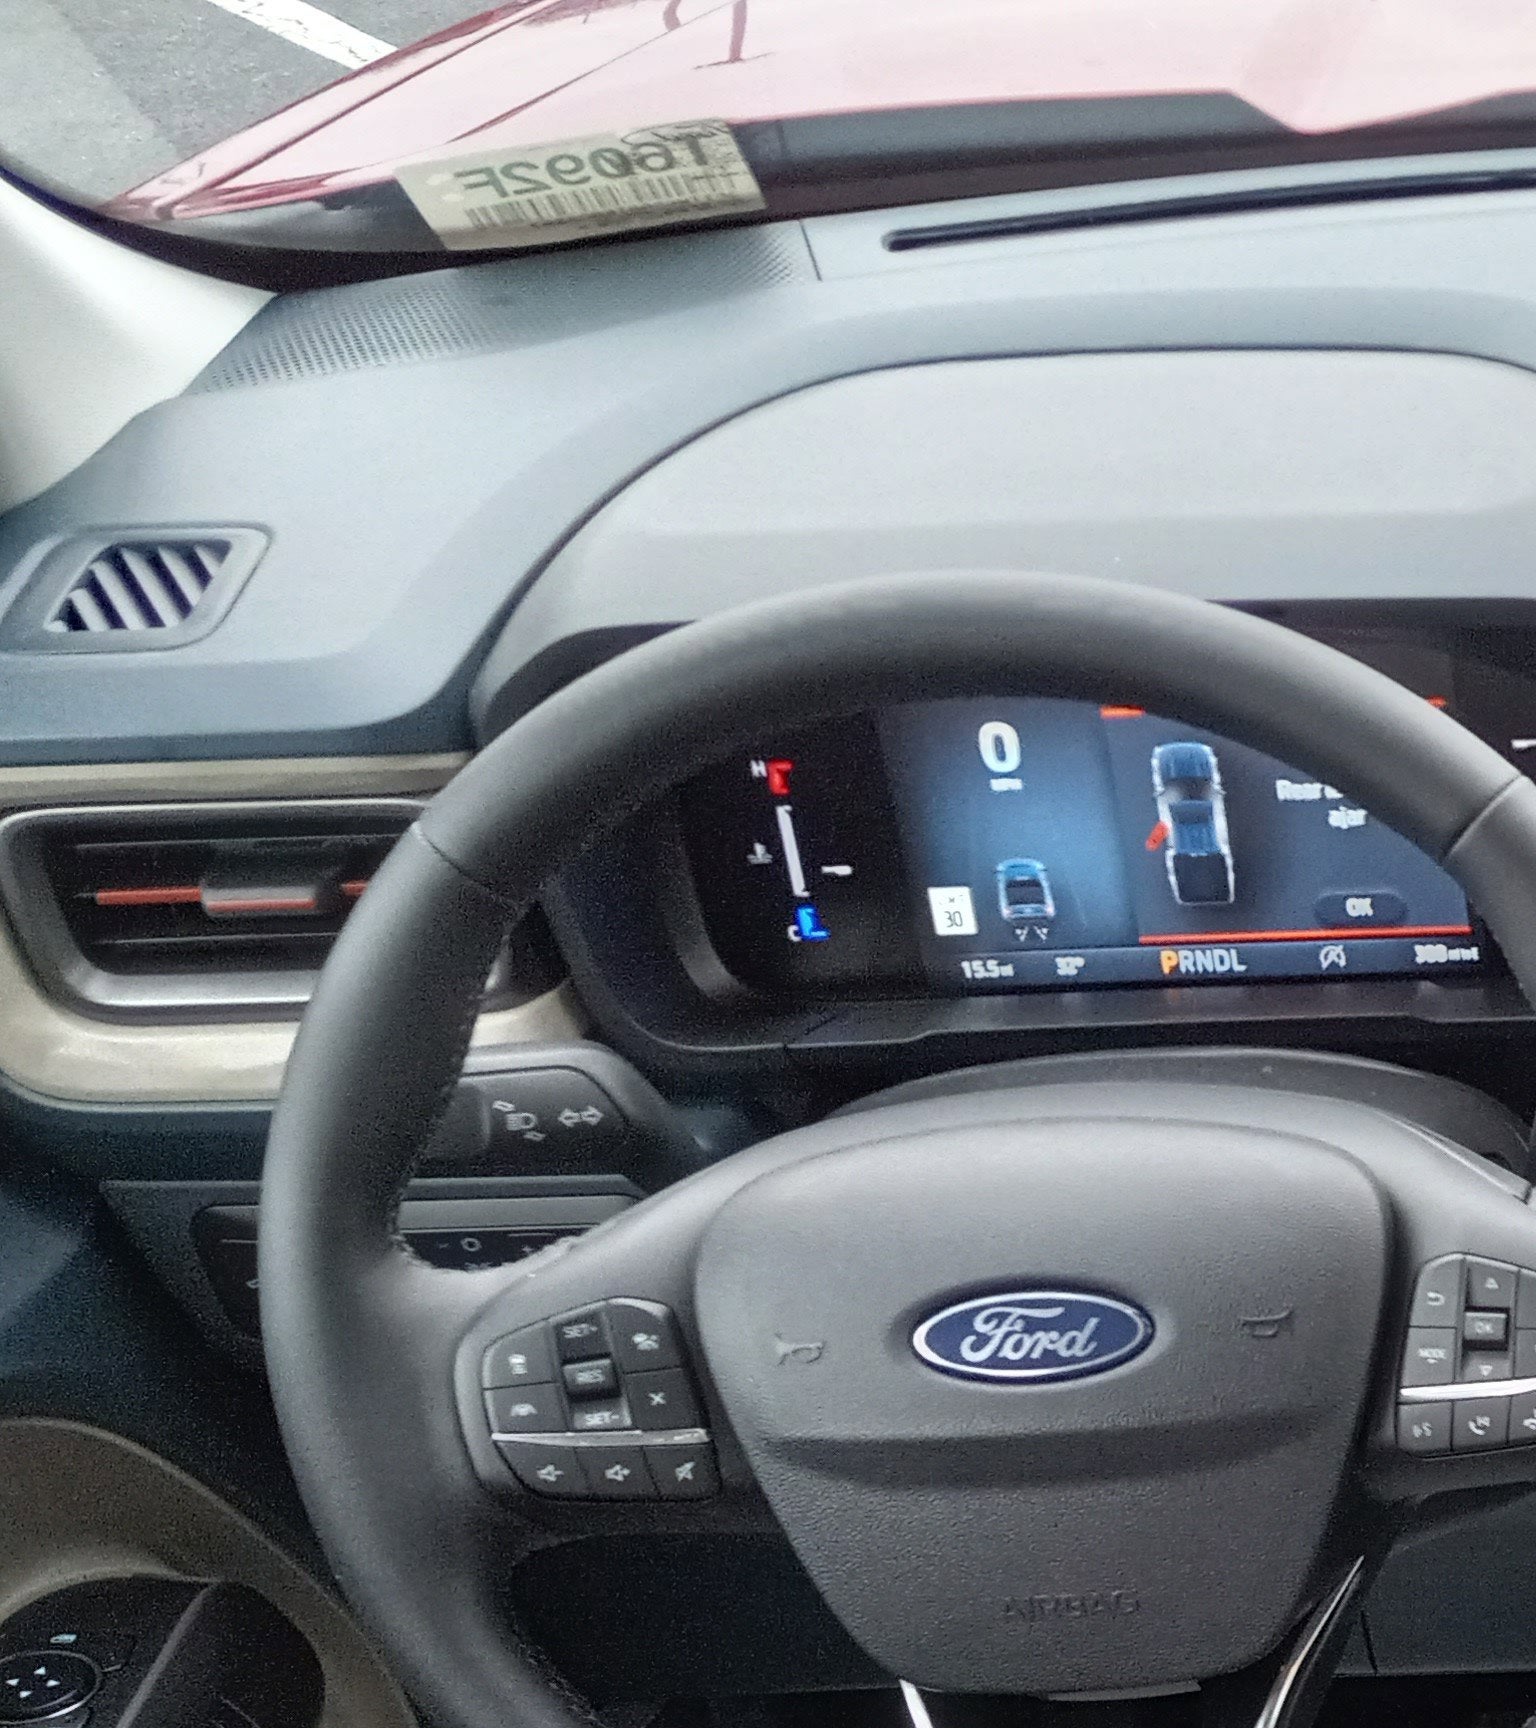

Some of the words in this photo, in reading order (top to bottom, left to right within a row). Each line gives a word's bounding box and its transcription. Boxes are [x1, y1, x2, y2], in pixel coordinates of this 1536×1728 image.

[978, 720, 1022, 774] 0
[944, 910, 963, 928] 30
[1345, 897, 1374, 918] OK
[958, 1304, 1100, 1368] Ford
